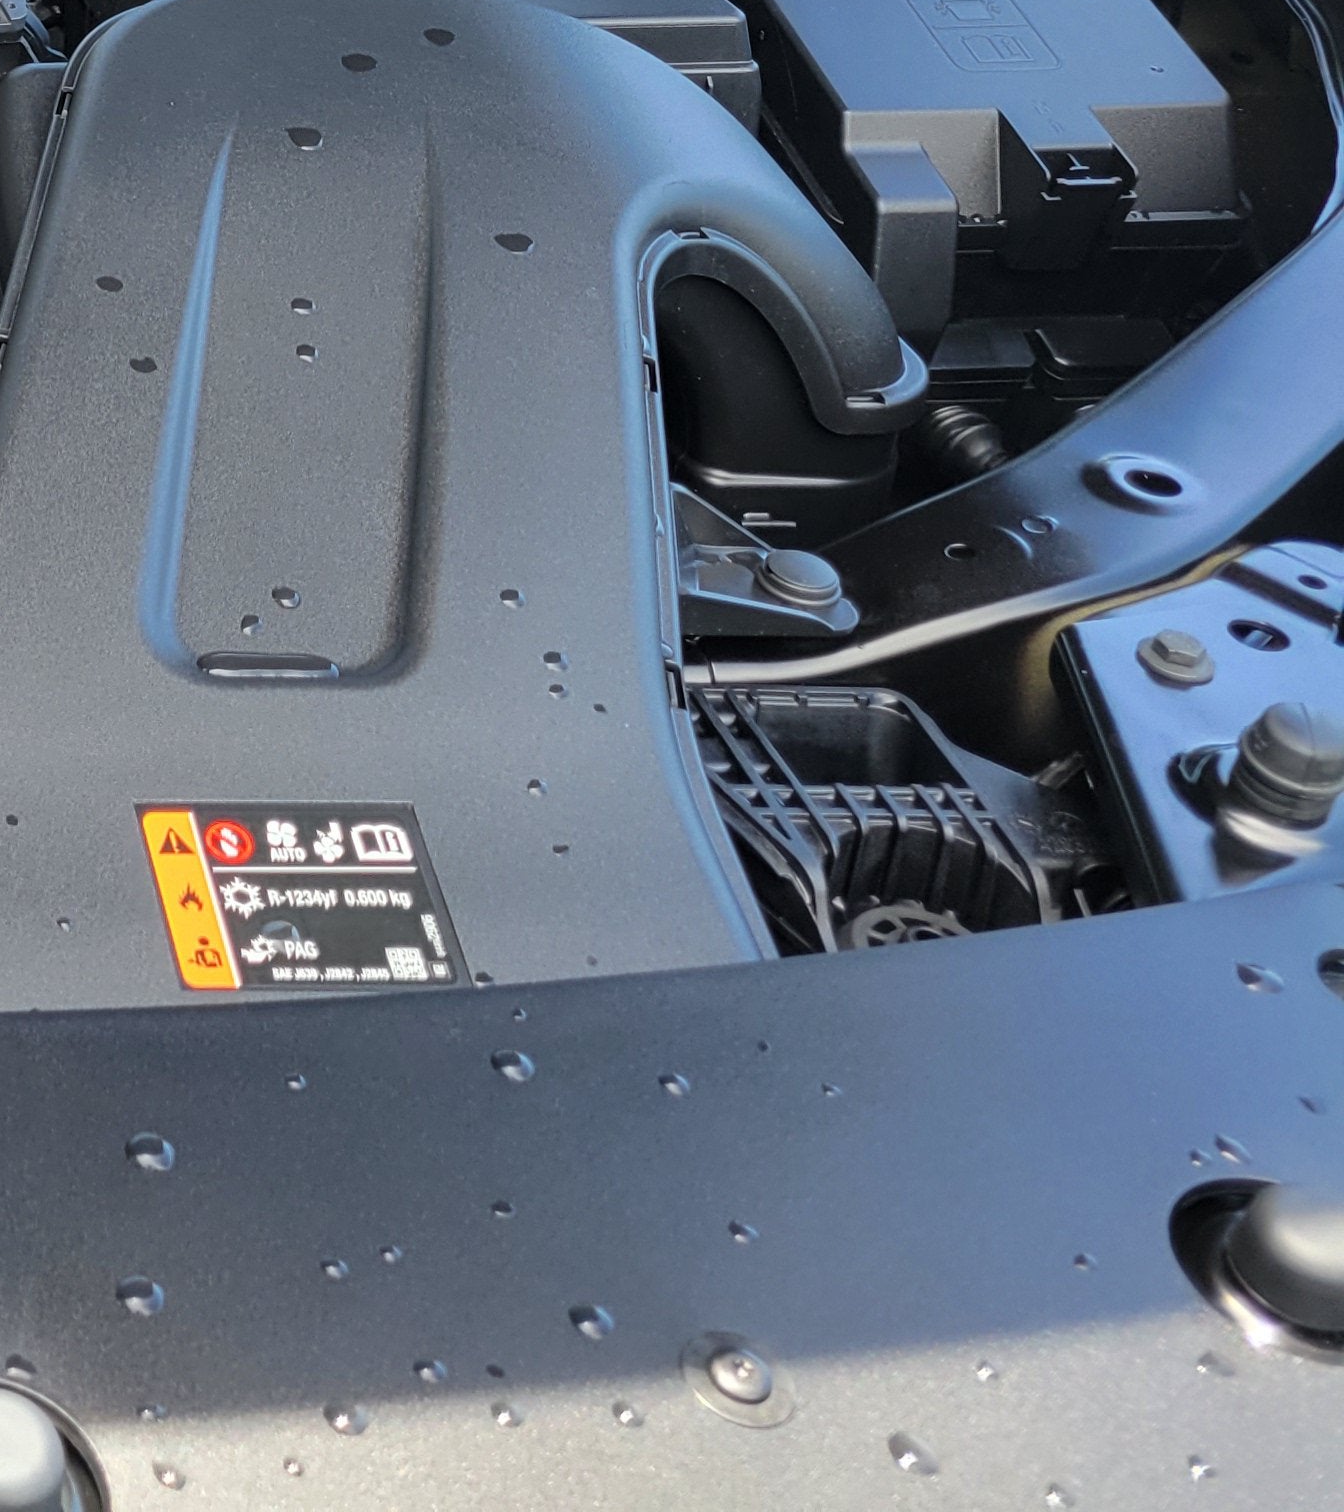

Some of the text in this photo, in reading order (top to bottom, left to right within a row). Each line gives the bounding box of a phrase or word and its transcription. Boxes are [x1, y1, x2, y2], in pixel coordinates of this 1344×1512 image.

[270, 847, 306, 862] AUTO
[267, 888, 412, 910] R-1234yf 0.600 kg
[285, 940, 319, 960] PAG
